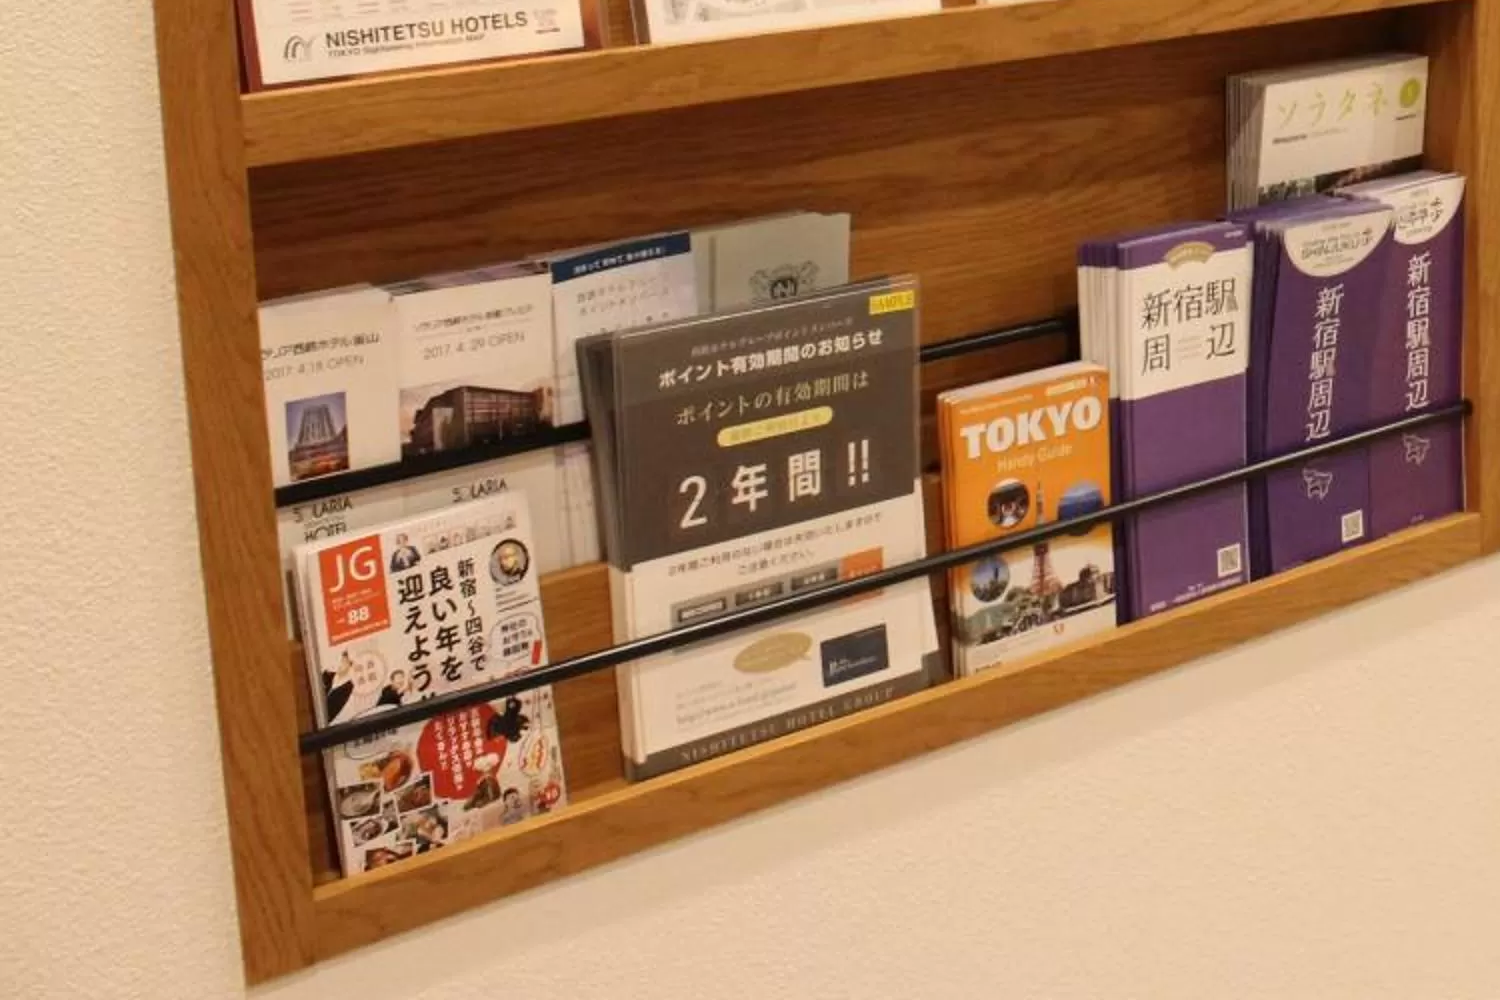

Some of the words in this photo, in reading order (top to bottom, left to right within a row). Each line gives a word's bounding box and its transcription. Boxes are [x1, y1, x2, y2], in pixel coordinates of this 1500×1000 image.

[325, 20, 445, 49] NISHITETSU
[450, 10, 529, 35] HOTELS
[1277, 81, 1389, 130] ソラタネ
[1141, 277, 1240, 331] 新宿駅
[1404, 250, 1434, 412] 新宿駅周辺
[658, 327, 884, 389] ポイント有効期間のお知らせ
[1141, 333, 1171, 377] 周
[1205, 321, 1236, 361] 辺
[1305, 283, 1346, 442] 新宿駅周辺
[676, 370, 870, 426] ポイントの有効期間は
[959, 394, 1103, 461] TOKYO
[329, 545, 378, 594] JG
[346, 605, 370, 626] 88
[397, 572, 434, 700] 迎えよう
[428, 564, 465, 683] 良い年を
[785, 704, 837, 731] HOTEL
